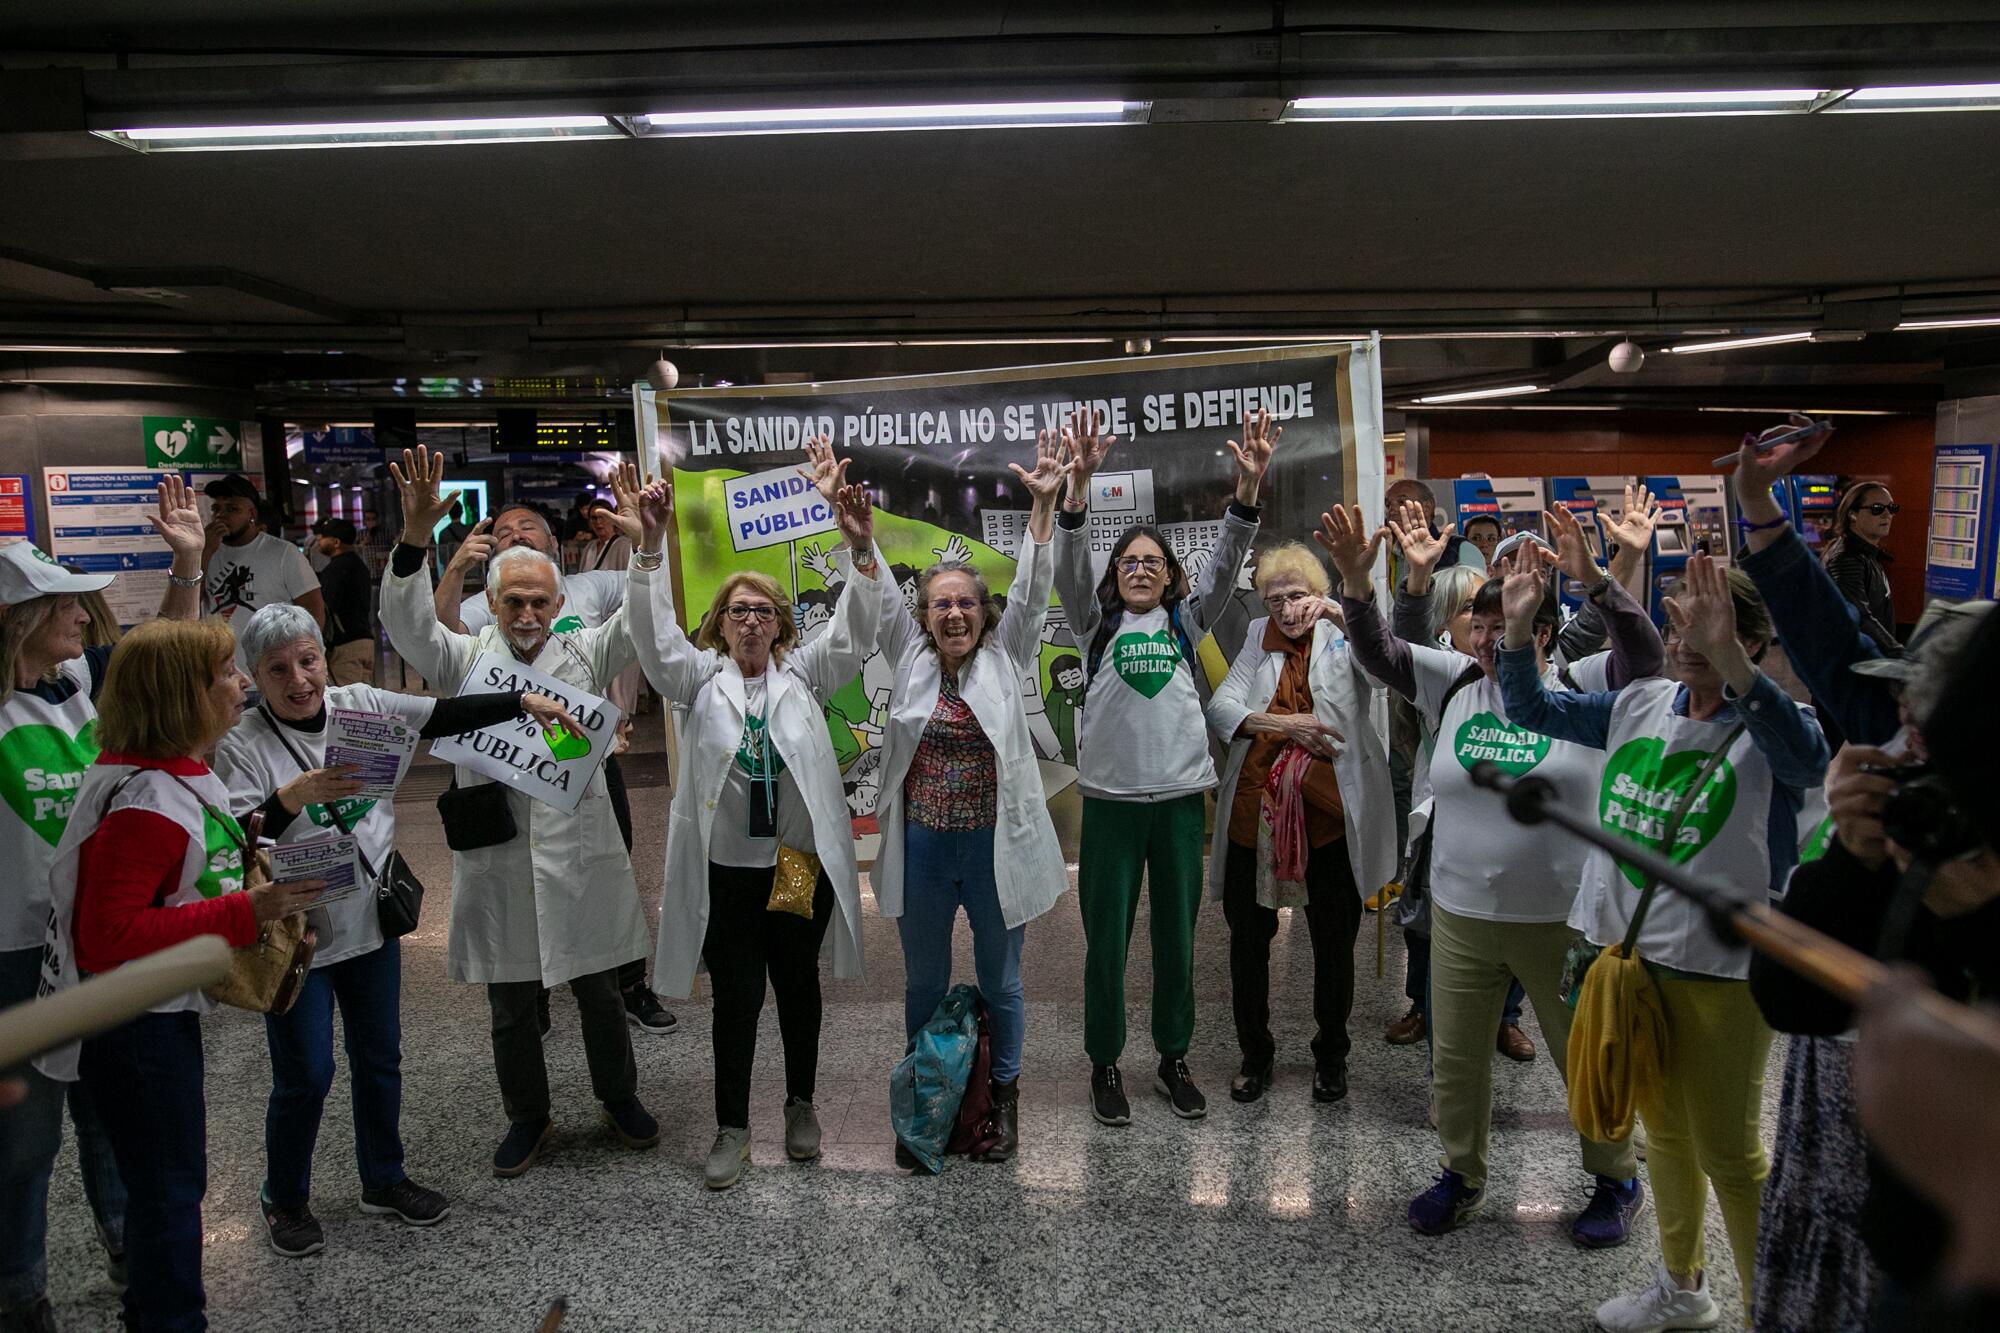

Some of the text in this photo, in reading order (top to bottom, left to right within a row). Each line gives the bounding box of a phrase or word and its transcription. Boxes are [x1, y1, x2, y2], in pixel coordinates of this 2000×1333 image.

[689, 420, 722, 456] LA
[726, 416, 836, 454] SANIDAD
[844, 406, 952, 447] PÚBLICA
[960, 407, 995, 443] NO
[1003, 405, 1036, 441] SE
[1143, 394, 1177, 432] SE
[1184, 382, 1313, 429] DEFIENDE
[733, 476, 817, 509] SANIDA
[1120, 641, 1175, 658] SANIDAD
[1120, 656, 1172, 676] PÚBLICA
[1467, 725, 1539, 746] SANIDAD
[454, 730, 572, 791] PUBLICA
[1458, 742, 1537, 763] PÚBLICA
